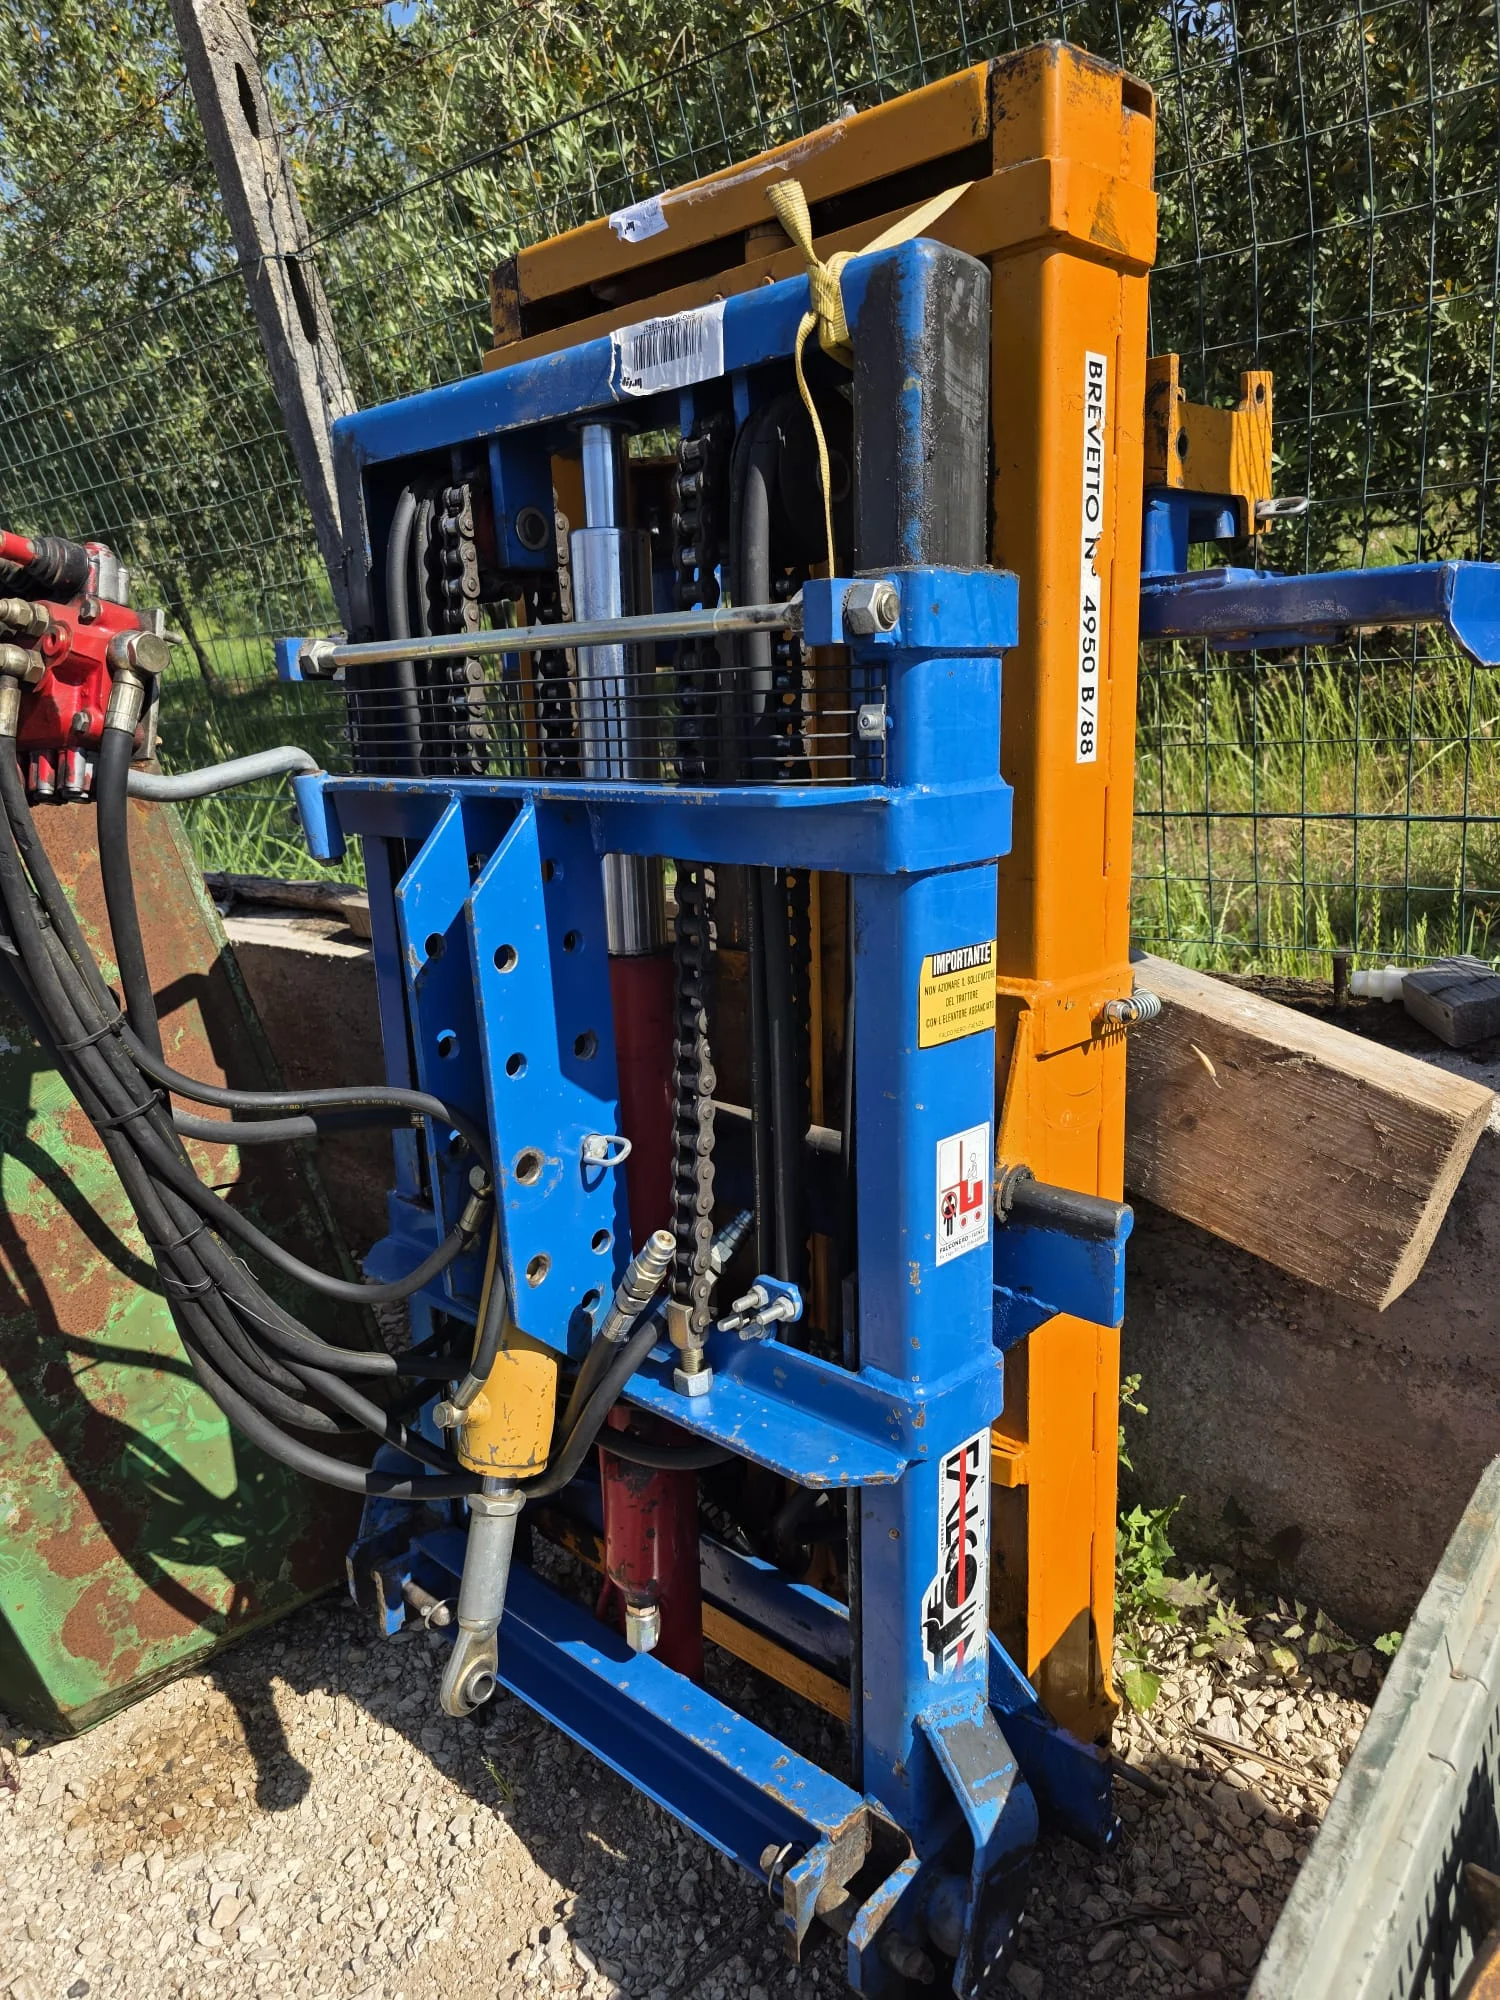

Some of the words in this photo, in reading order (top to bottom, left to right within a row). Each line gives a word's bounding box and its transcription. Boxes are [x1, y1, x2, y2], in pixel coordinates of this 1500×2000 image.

[1086, 360, 1103, 523] BREVETTO
[1082, 594, 1097, 674] 4950
[1079, 686, 1095, 756] B/88
[933, 942, 991, 976] IMPORTANTE
[924, 984, 936, 997] NON
[938, 979, 960, 993] AZIONARE
[945, 996, 955, 1008] DEL
[956, 990, 978, 1004] TRATTORE
[925, 1017, 938, 1029] CON
